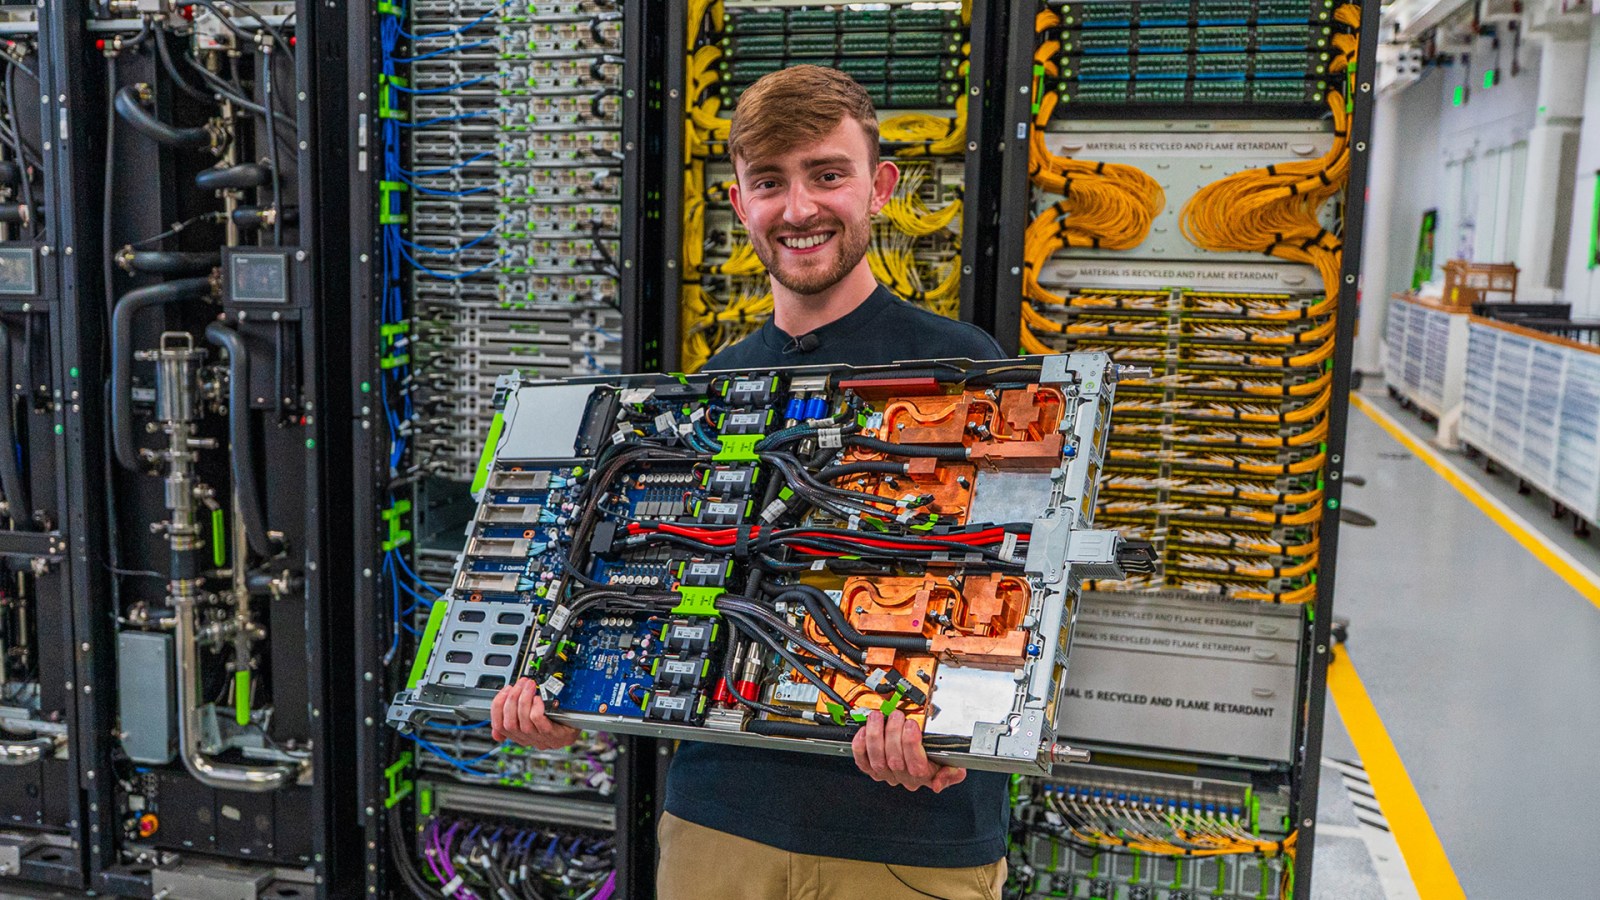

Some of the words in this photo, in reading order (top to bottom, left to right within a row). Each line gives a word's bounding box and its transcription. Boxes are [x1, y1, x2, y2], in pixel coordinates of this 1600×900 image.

[1086, 142, 1127, 150] MATERIAL
[1129, 142, 1137, 150] IS
[1139, 142, 1183, 151] RECYCLED
[1184, 142, 1203, 150] AND
[1205, 142, 1233, 150] FLAME
[1236, 142, 1288, 151] RETARDANT
[1080, 268, 1120, 276] MATERIAL
[1132, 269, 1175, 278] RECYCLED
[1176, 270, 1195, 278] AND
[1197, 271, 1225, 279] FLAME
[1227, 271, 1279, 280] RETARDANT
[1109, 633, 1151, 644] RECYCLED
[1172, 639, 1200, 649] FLAME
[1202, 641, 1251, 653] RETARDANT
[610, 683, 620, 706] Quanta
[1084, 689, 1094, 700] IS
[1097, 690, 1148, 705] RECYCLED
[1150, 696, 1173, 707] AND
[1175, 698, 1210, 711] FLAME
[1213, 701, 1275, 717] RETARDANT
